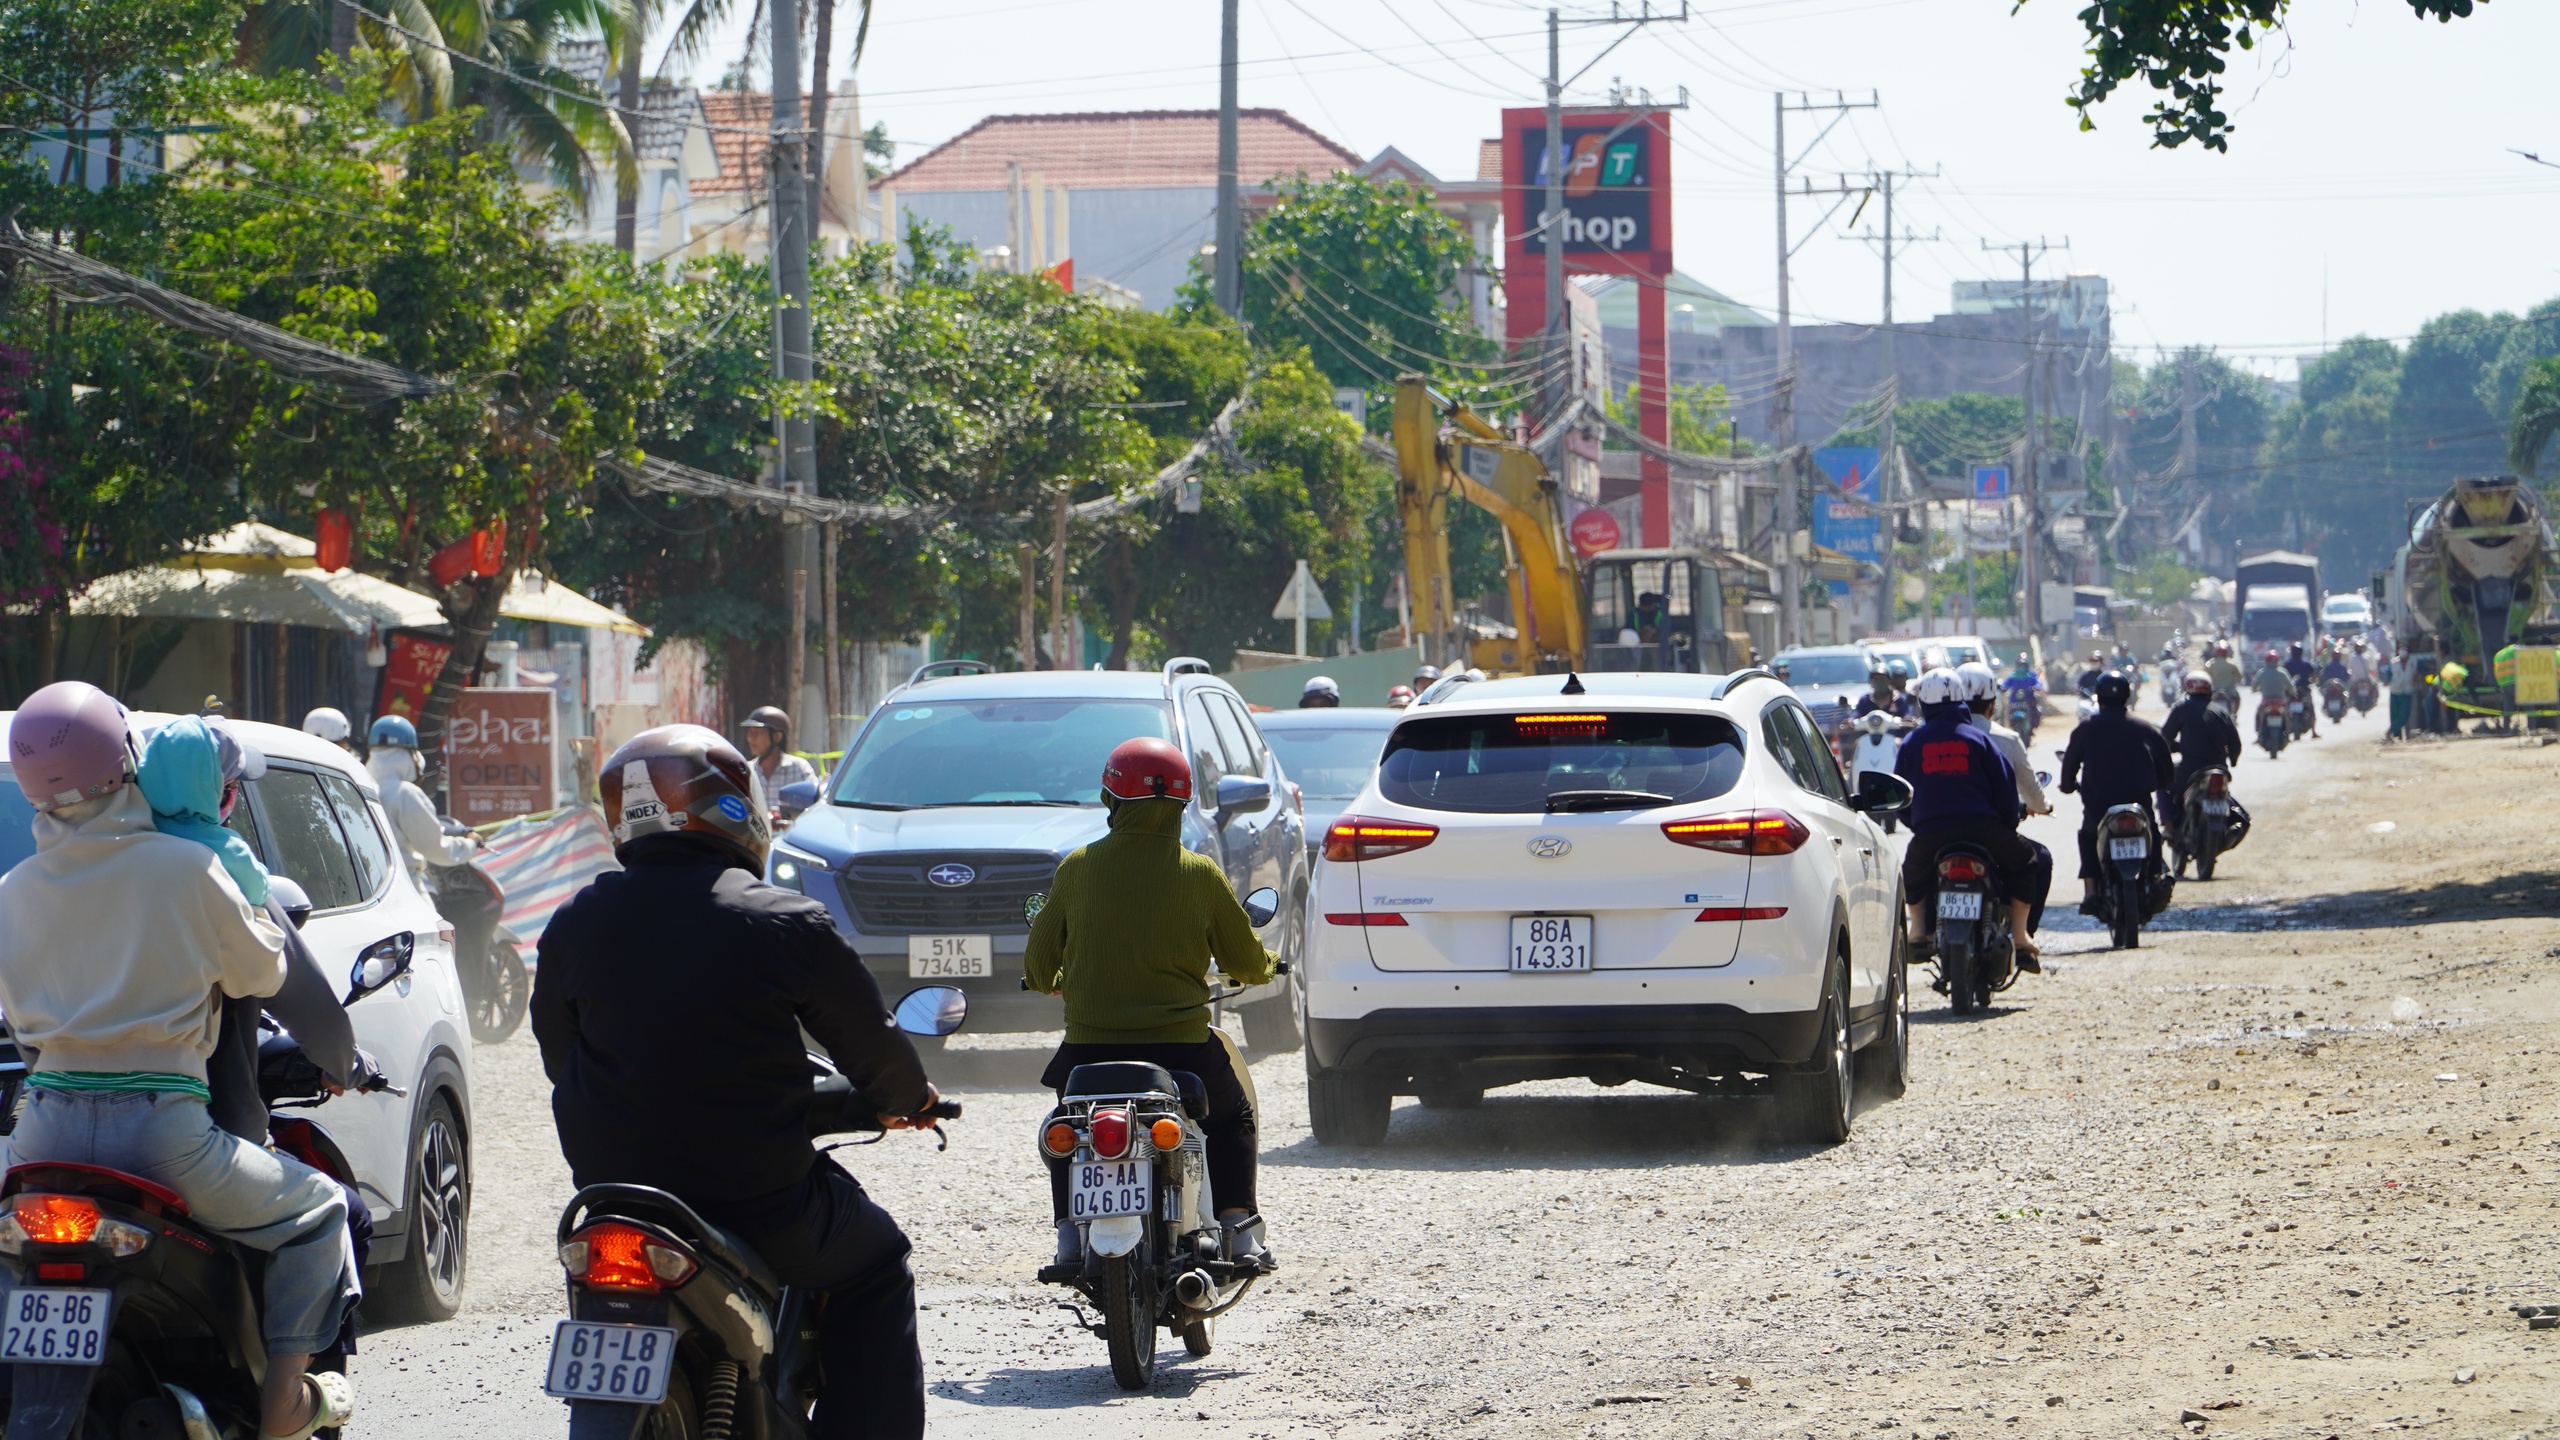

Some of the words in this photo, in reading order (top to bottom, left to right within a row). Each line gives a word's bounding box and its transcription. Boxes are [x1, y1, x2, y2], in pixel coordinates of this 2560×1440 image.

[2527, 681, 2549, 700] XE
[450, 709, 551, 755] pha.
[459, 763, 542, 787] OPEN
[625, 803, 661, 821] INDEX
[1940, 905, 1977, 918] 932.81
[1530, 919, 1572, 943] 86A
[932, 938, 967, 956] 51K
[1514, 945, 1585, 969] 143.31
[918, 958, 982, 976] 734.85
[1082, 1162, 1138, 1189] 86-AA
[1074, 1187, 1146, 1216] 046.05
[20, 1293, 93, 1324] 86-B6
[4, 1327, 98, 1359] 246.98
[571, 1327, 658, 1362] 61-L8
[564, 1360, 651, 1395] 8360
